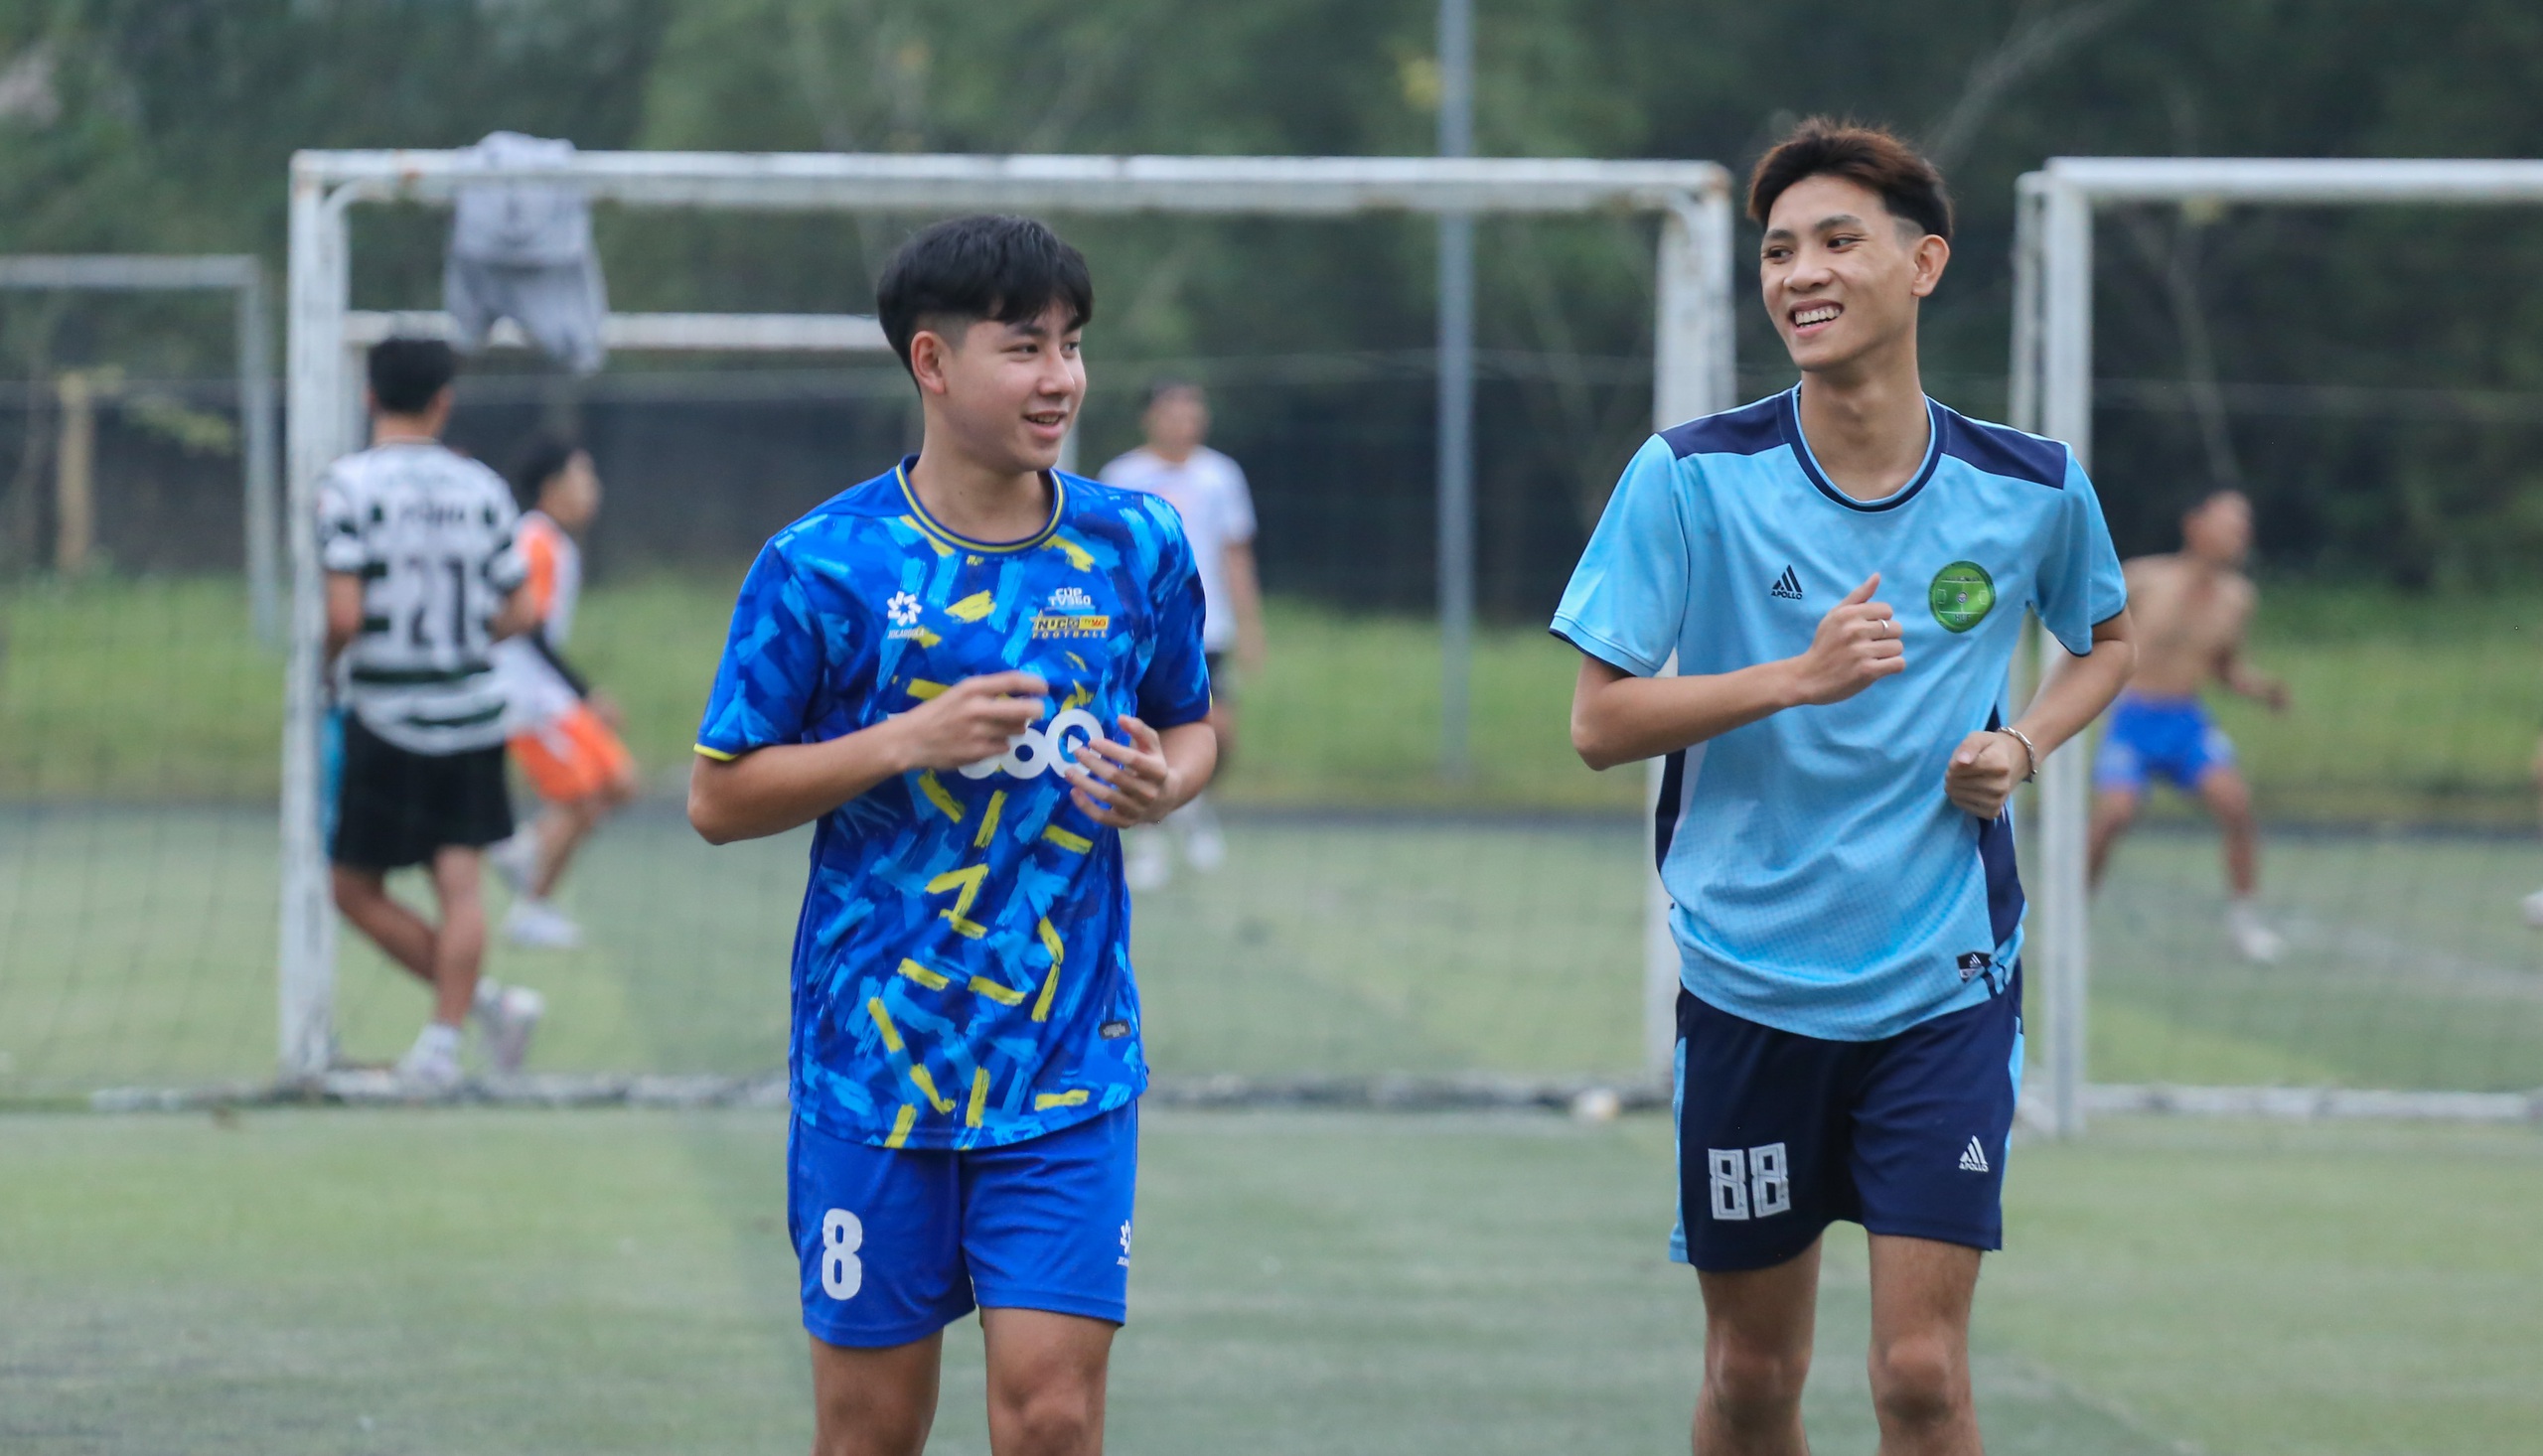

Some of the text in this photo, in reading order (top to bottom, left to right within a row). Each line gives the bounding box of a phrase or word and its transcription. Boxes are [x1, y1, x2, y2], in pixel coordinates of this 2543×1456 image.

[1771, 590, 1803, 600] APOLLO
[1031, 630, 1108, 640] FOOTBALL
[1958, 1162, 1990, 1173] APOLLO
[1708, 1142, 1791, 1221] 88
[822, 1208, 863, 1301] 8
